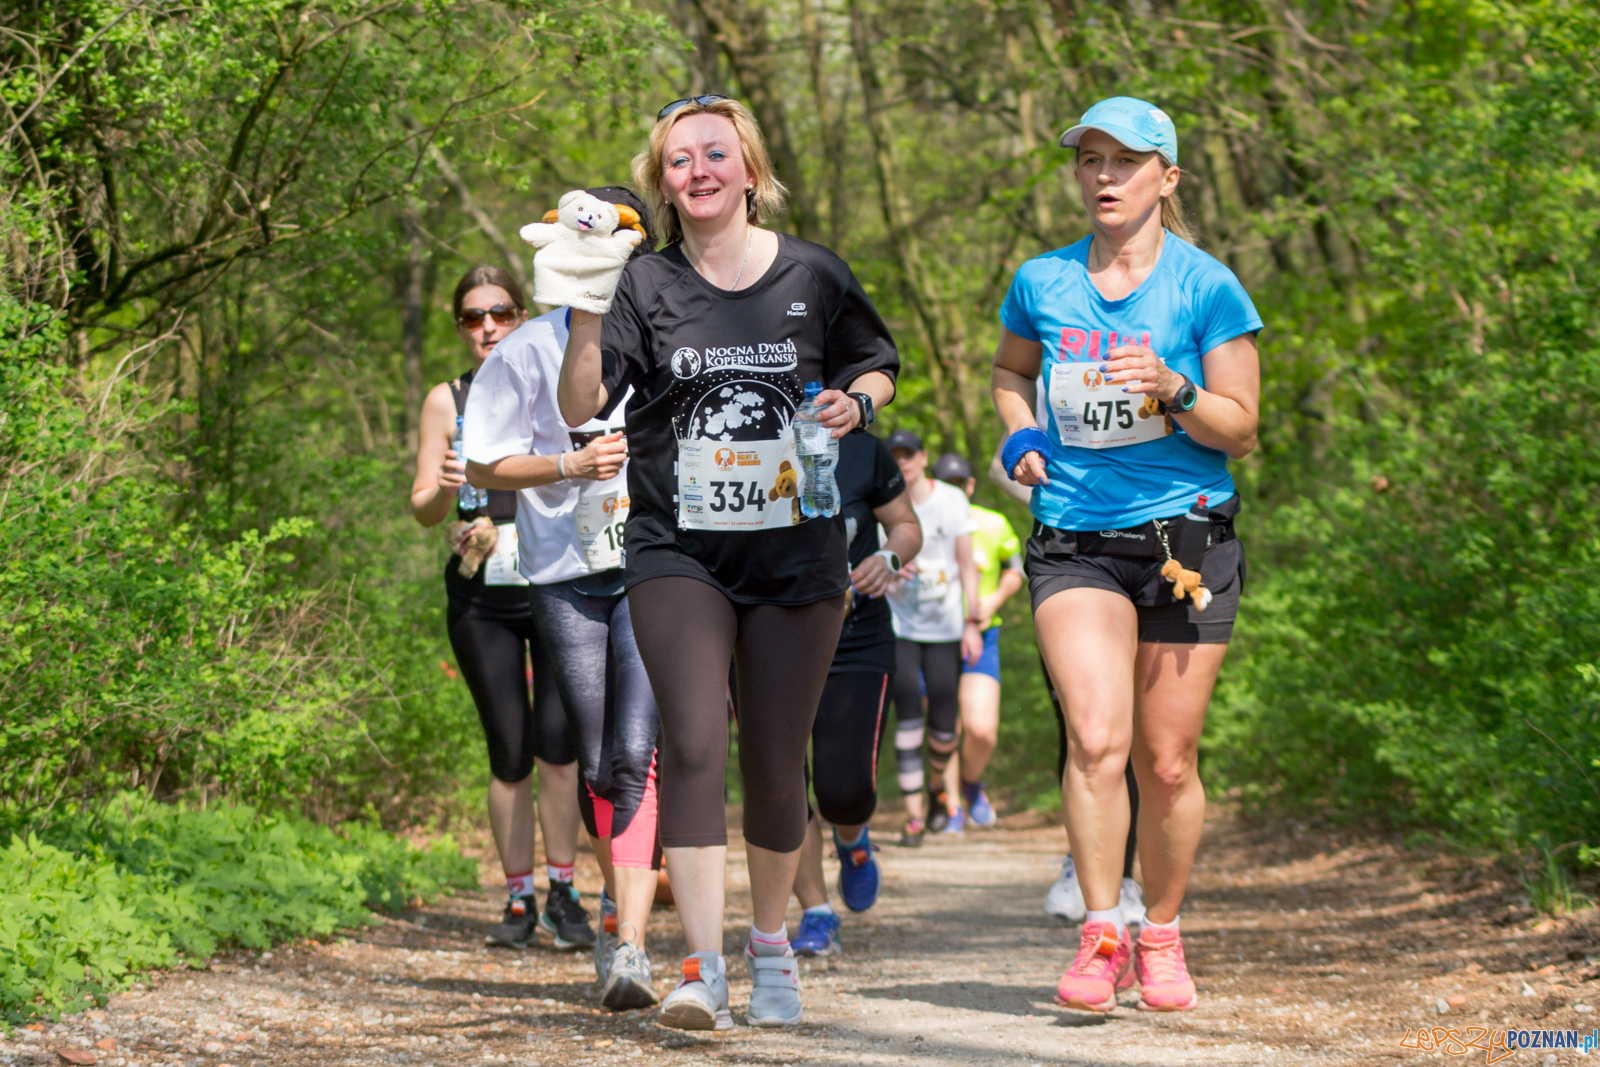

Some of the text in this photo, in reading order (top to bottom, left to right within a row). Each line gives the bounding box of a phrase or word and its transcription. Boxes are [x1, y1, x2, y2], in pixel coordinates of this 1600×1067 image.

[705, 341, 798, 358] NOCNA DYCHA
[1083, 400, 1134, 431] 475
[709, 481, 766, 512] 334
[1118, 531, 1147, 541] Kalenji
